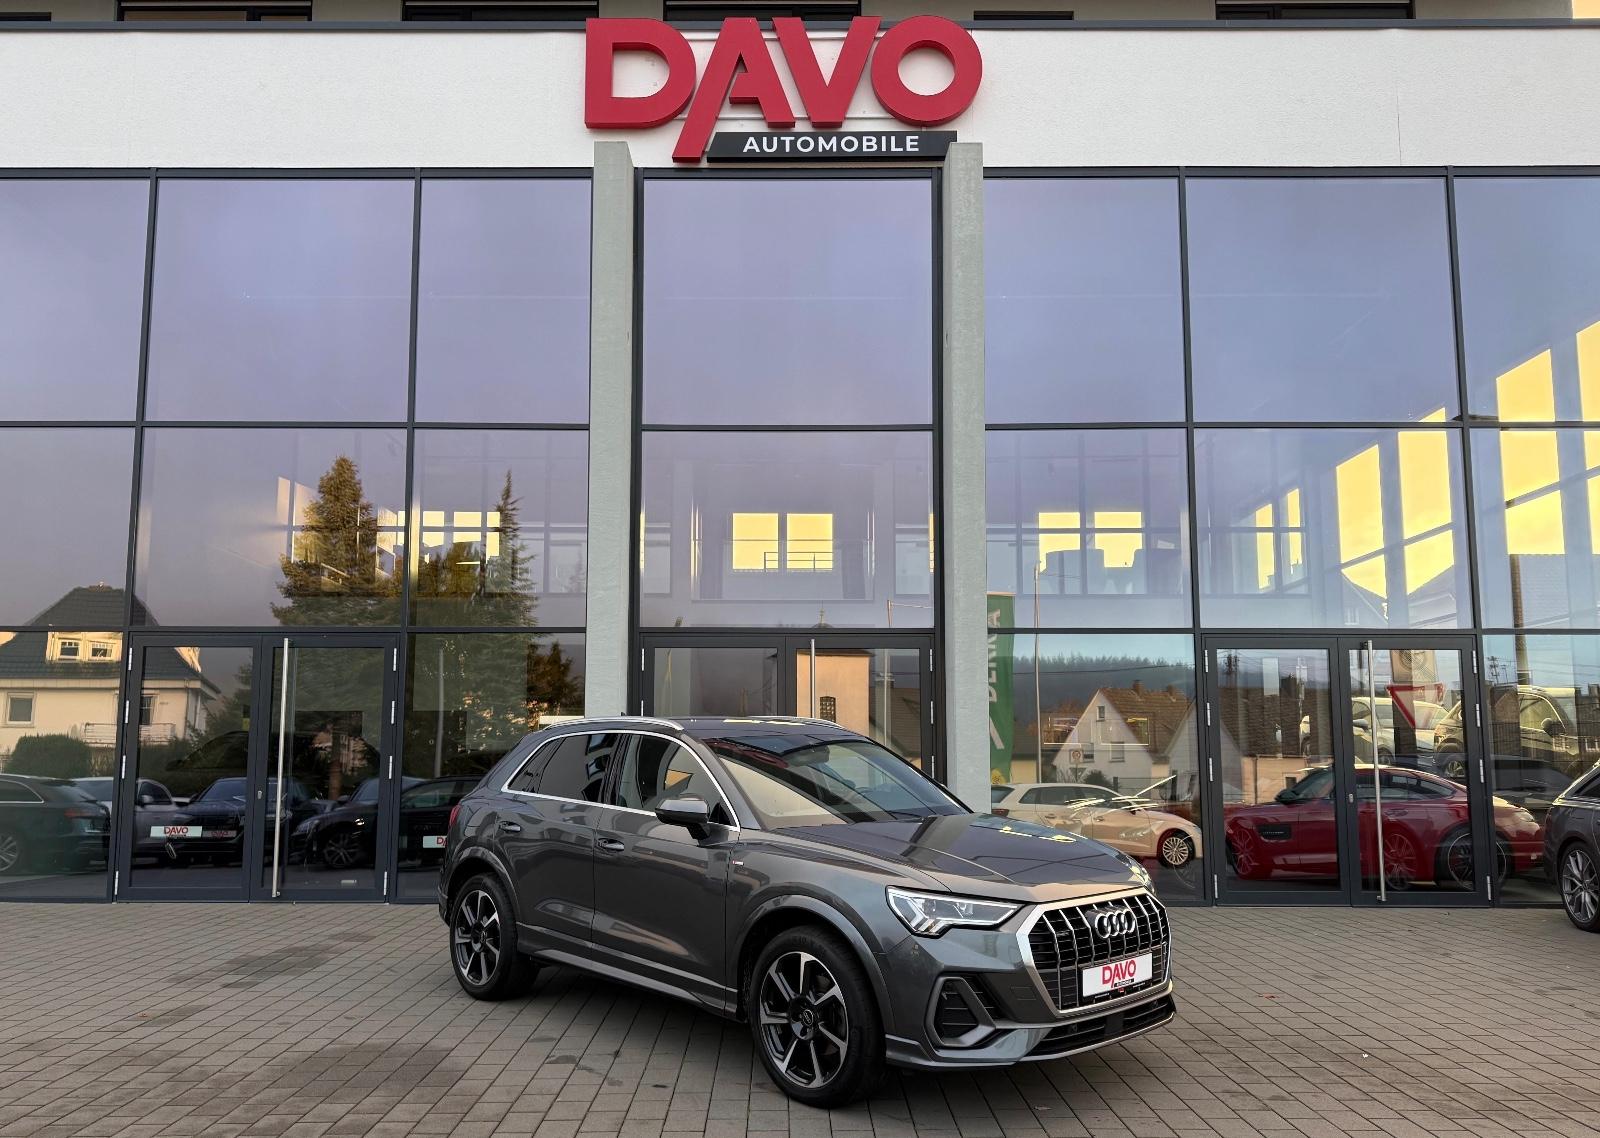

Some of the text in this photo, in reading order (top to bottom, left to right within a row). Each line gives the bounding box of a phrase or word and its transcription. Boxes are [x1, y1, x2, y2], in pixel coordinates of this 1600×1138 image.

[584, 14, 984, 164] DAVO
[742, 135, 920, 154] AUTOMOBILE
[164, 826, 189, 836] DAVO
[1102, 959, 1137, 989] DAVO
